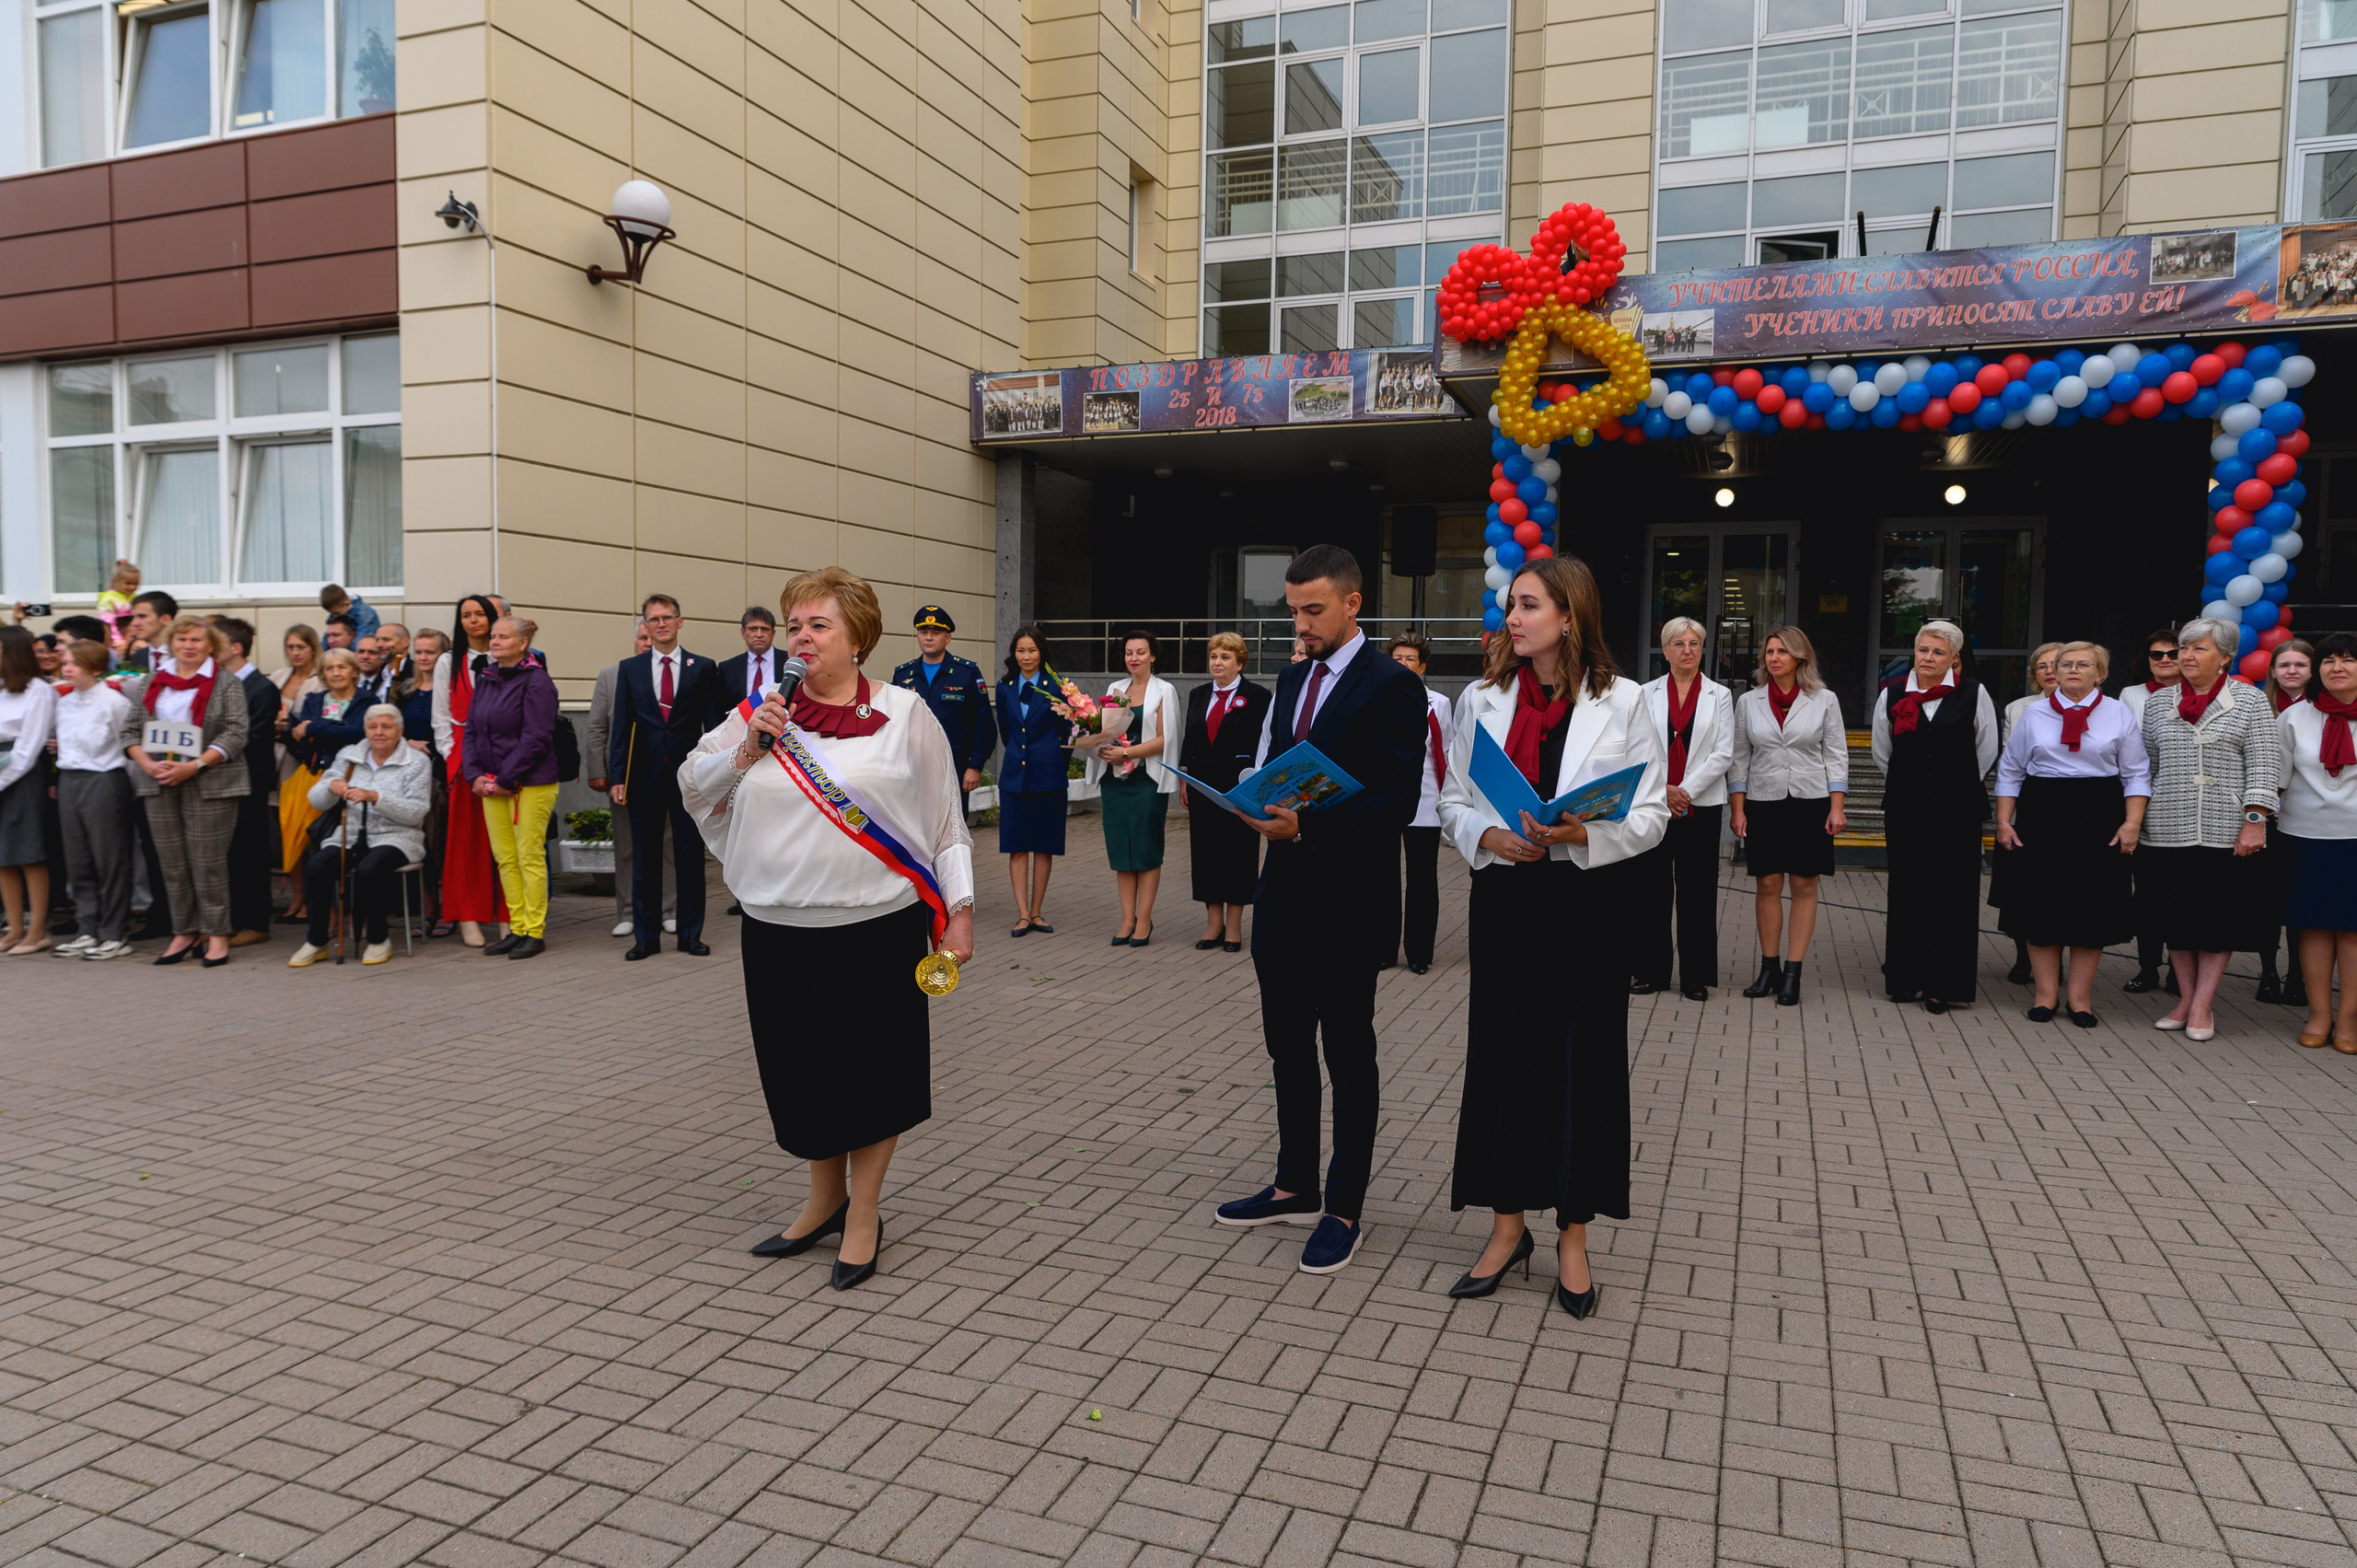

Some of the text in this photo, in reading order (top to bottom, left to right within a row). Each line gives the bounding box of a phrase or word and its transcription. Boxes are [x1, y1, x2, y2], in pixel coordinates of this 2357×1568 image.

[1668, 250, 2139, 307] УЧИТЕЛЯМИ СЛАВИТСЯ РОССИЯ,
[1744, 285, 2187, 338] УЧЕНИКИ ПРИНОСЯТ СЛАВУ ЕЙ!
[1206, 386, 1222, 406] И
[1194, 406, 1237, 427] 2018
[177, 730, 194, 747] Б
